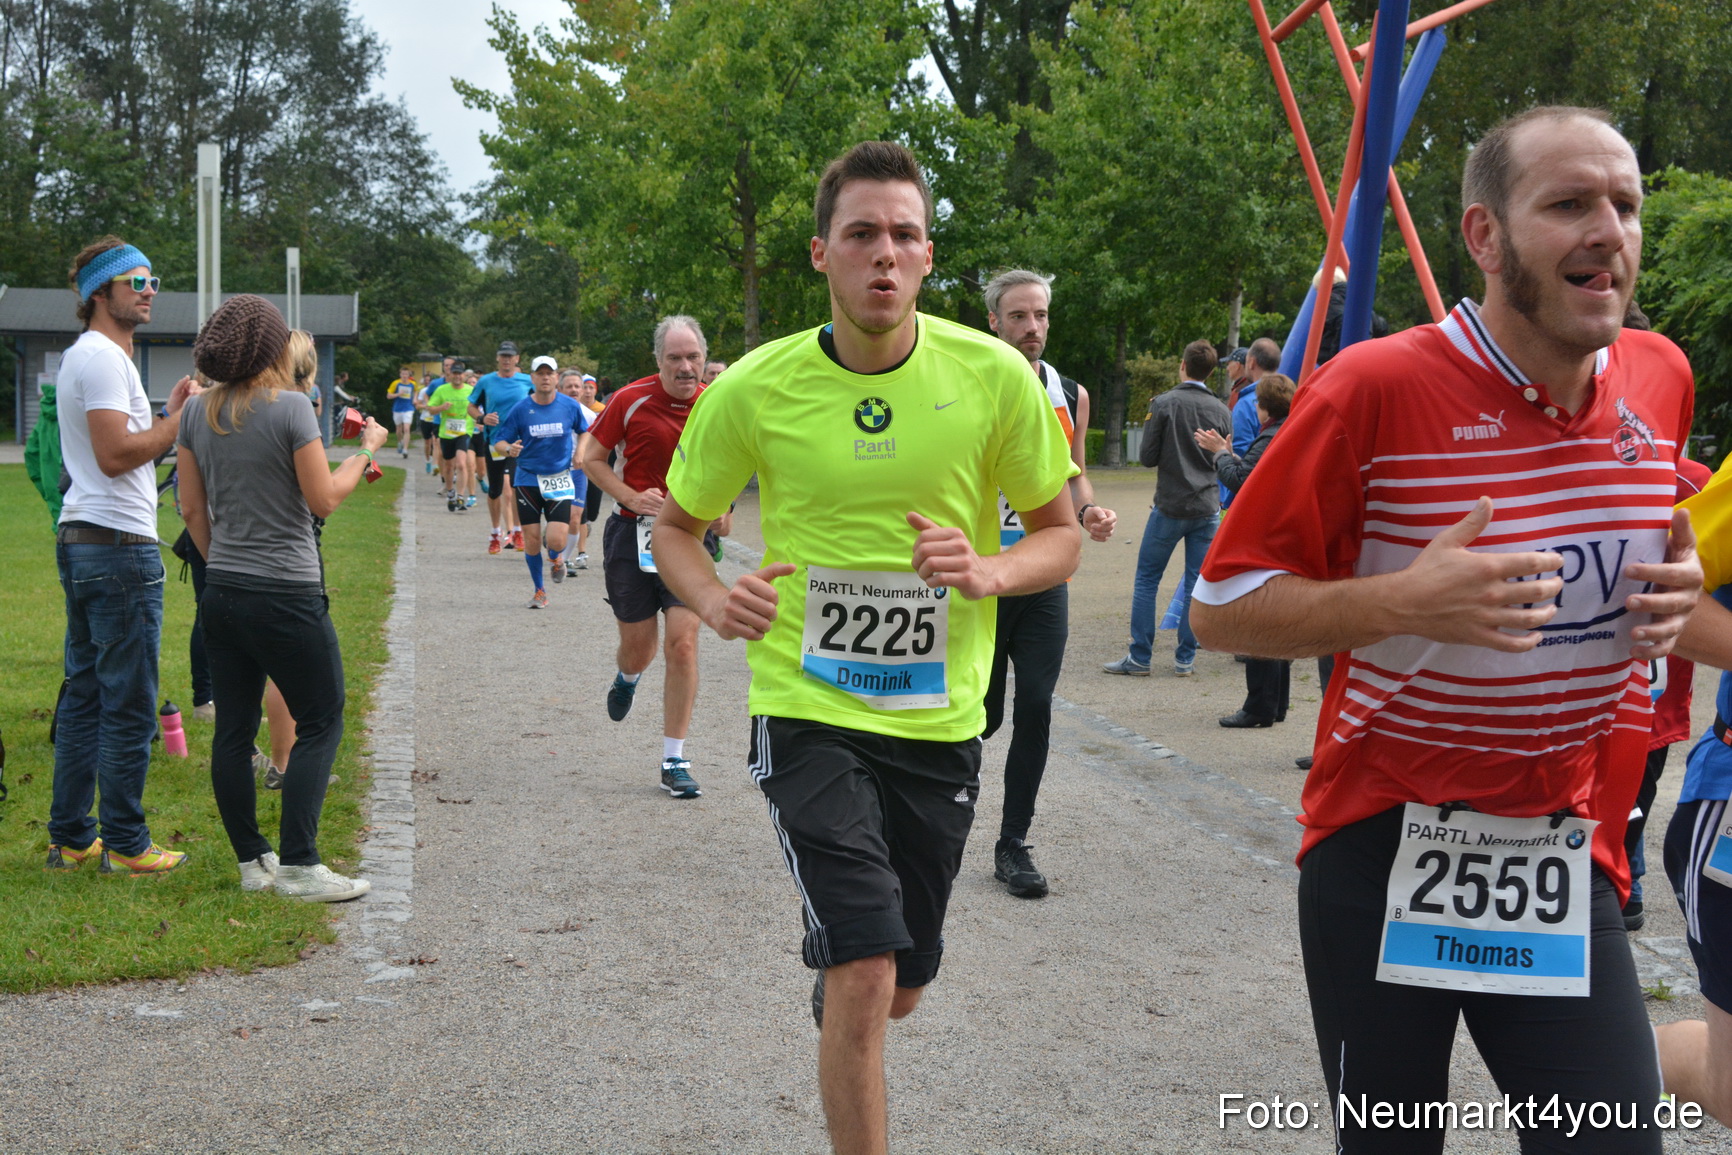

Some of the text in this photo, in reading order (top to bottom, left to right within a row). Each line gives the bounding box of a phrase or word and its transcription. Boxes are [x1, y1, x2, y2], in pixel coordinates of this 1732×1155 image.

[529, 422, 563, 433] HUBER
[1452, 424, 1501, 442] PUMA
[853, 437, 896, 453] Partl
[854, 452, 897, 461] Neumarkt
[542, 476, 571, 491] 2935
[809, 579, 930, 599] PARTL Neumarkt
[818, 601, 936, 657] 2225
[808, 645, 814, 654] A
[837, 666, 913, 691] Dominik
[1407, 822, 1471, 846] PARTL
[1477, 832, 1559, 848] Neumarkt
[1409, 850, 1570, 925] 2559
[1395, 907, 1402, 919] B
[1434, 934, 1534, 969] Thomas
